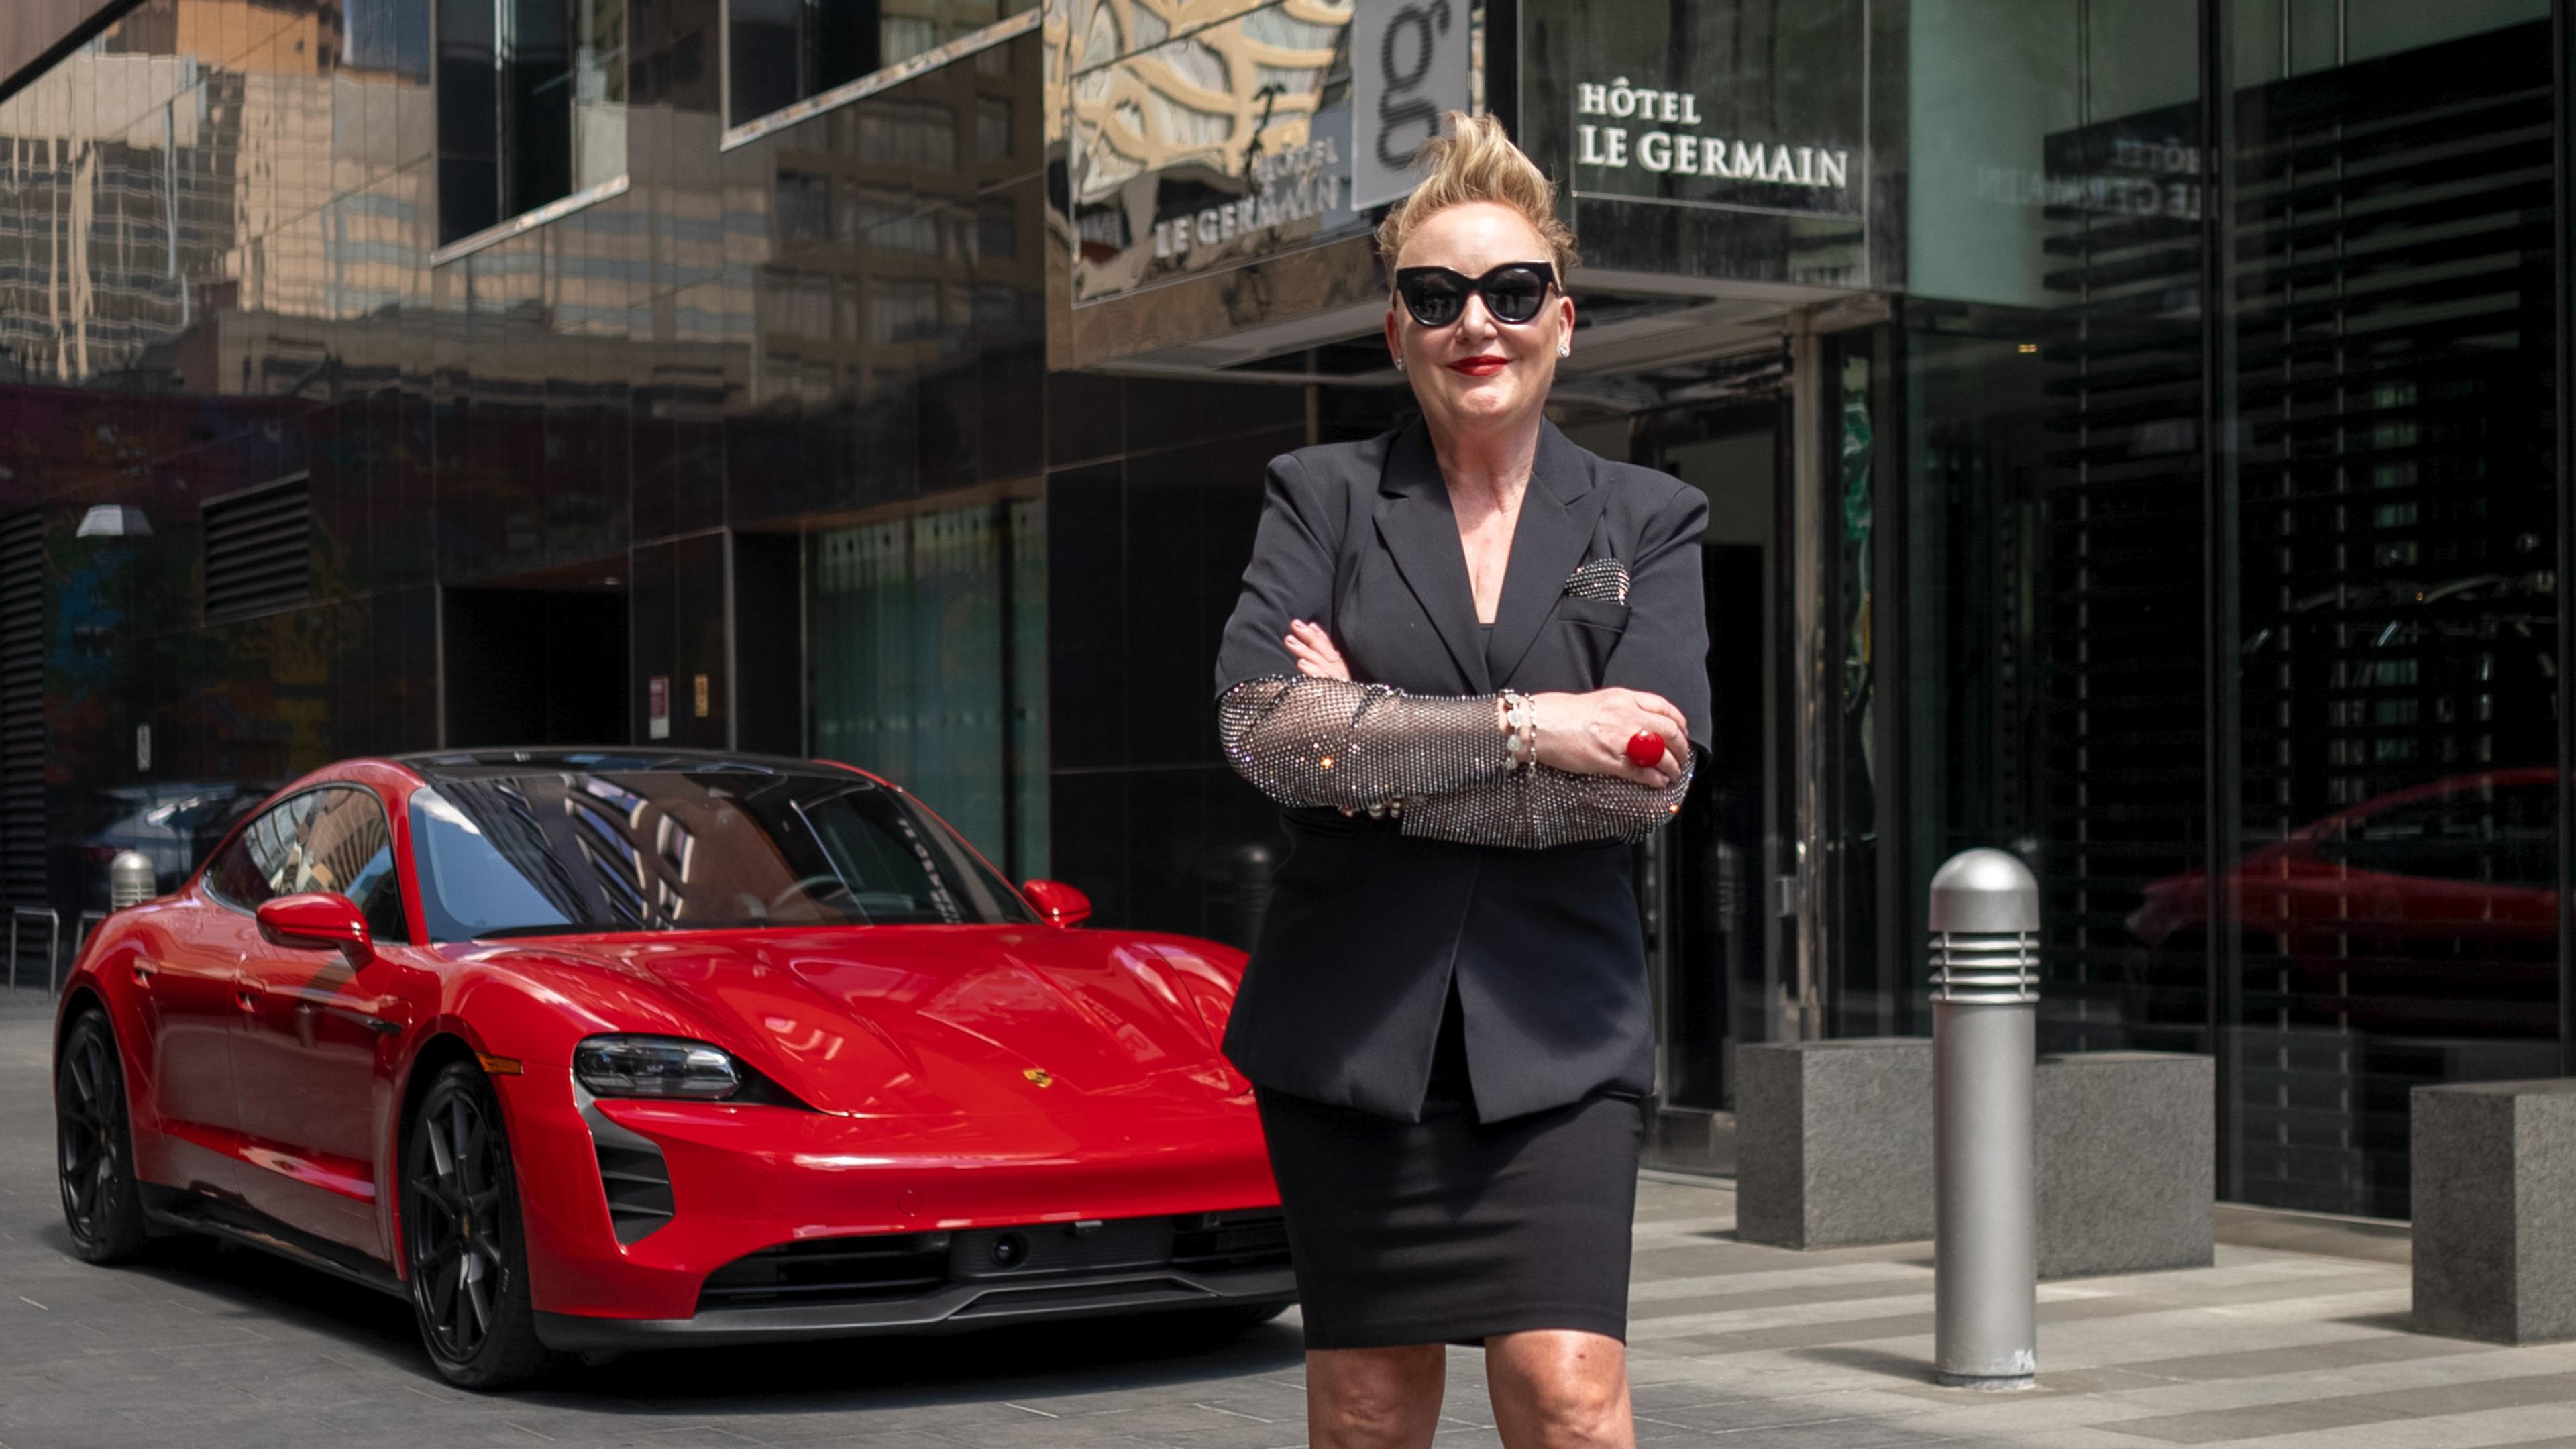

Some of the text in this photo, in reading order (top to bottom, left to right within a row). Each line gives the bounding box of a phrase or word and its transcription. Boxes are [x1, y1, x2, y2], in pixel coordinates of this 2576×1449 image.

[1377, 0, 1451, 171] g
[1578, 76, 1702, 125] HÔTEL
[1578, 124, 1848, 188] LE GERMAIN
[1155, 175, 1338, 258] LE GERMAIN
